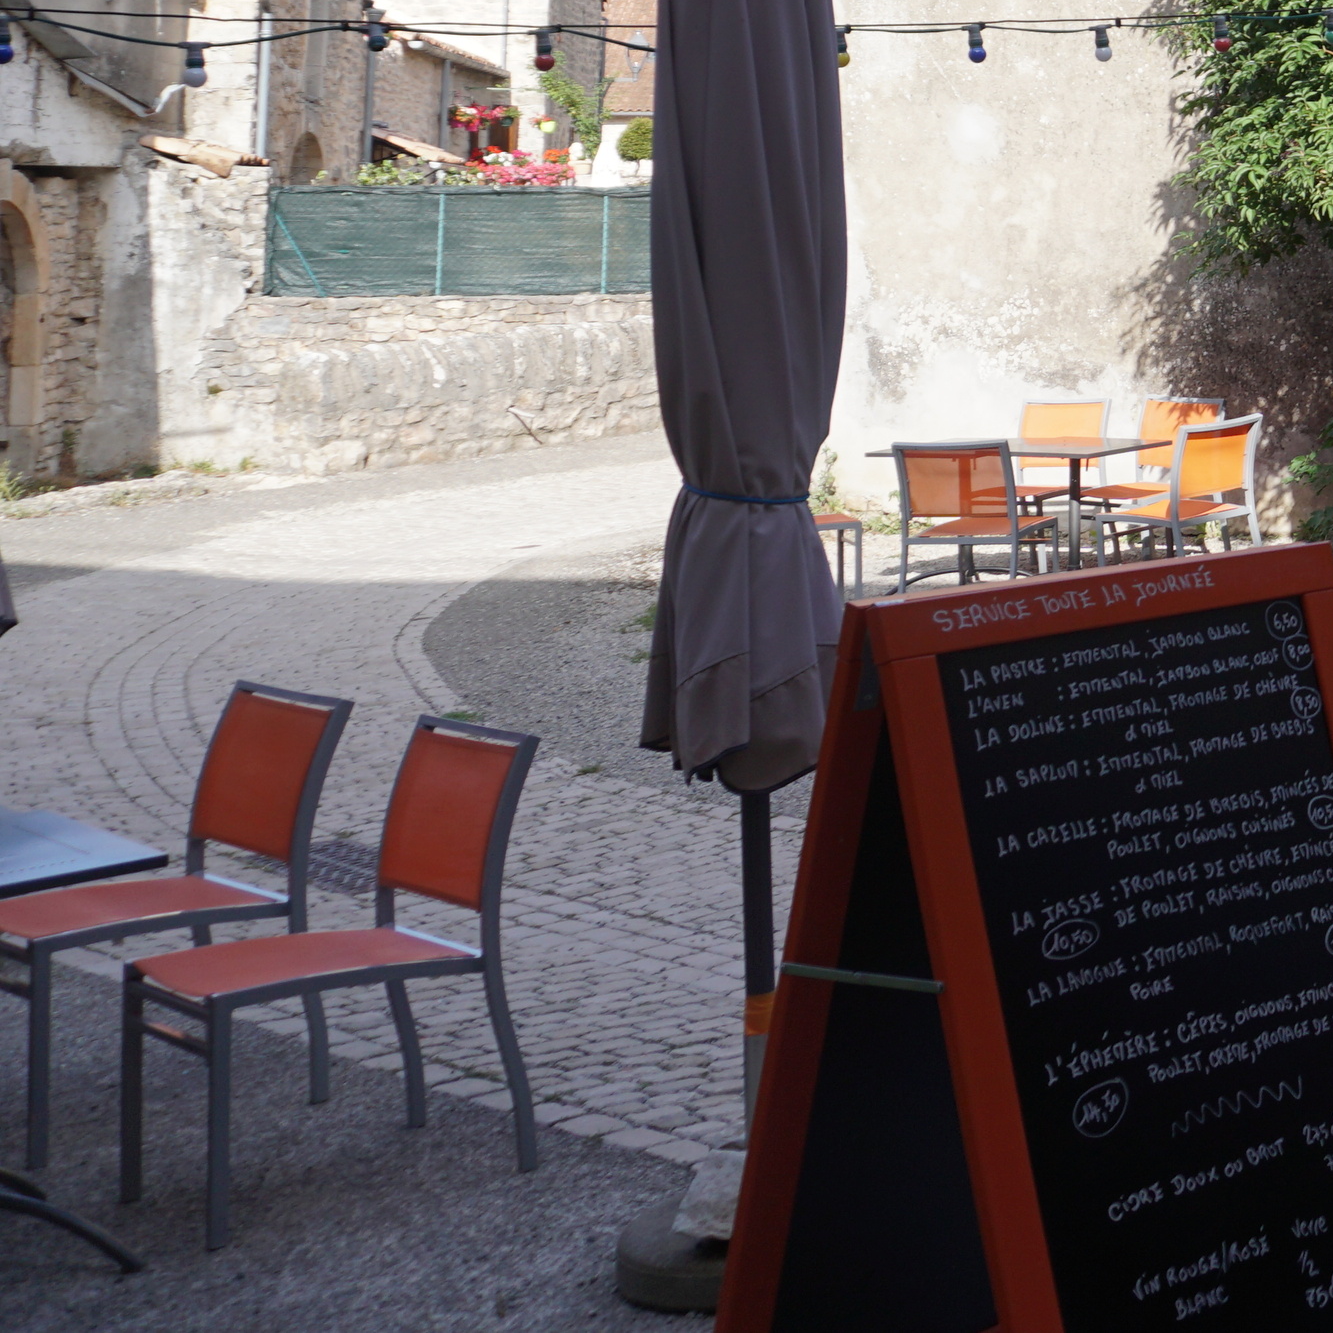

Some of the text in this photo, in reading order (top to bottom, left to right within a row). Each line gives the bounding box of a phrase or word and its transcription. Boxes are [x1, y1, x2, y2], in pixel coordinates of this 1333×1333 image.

[932, 565, 1216, 633] SERVICE TOUTE LA JOURNÉE
[1273, 612, 1298, 632] 6,50
[960, 668, 987, 692] LA
[1148, 630, 1205, 659] JAMBON
[1207, 621, 1251, 641] BLANC
[1286, 643, 1311, 662] 8,00
[968, 692, 1025, 719] L'AVEN
[1156, 666, 1210, 689] JAMBON
[974, 727, 1002, 752] LA
[1168, 685, 1228, 711] FROMAGE
[1233, 680, 1252, 701] DE
[1255, 672, 1299, 697] CHÈVRE
[1295, 694, 1318, 717] 8,50
[1140, 719, 1175, 738] MIEL
[984, 774, 1009, 799] LA
[1189, 731, 1248, 758] FROMAGE
[1250, 723, 1268, 744] DE
[1271, 718, 1315, 739] BREBIS
[1151, 770, 1184, 790] MIEL
[996, 833, 1021, 858] LA
[1112, 804, 1180, 834] FROMAGE
[1183, 799, 1205, 822] DE
[1174, 822, 1237, 849] OIGNONS
[1241, 806, 1296, 836] CUISINÉS
[1012, 911, 1036, 936] LA
[1119, 861, 1199, 899] FROMAGE
[1203, 858, 1225, 880] DE
[1114, 905, 1138, 928] DE
[1271, 868, 1325, 894] OIGNONS
[1052, 928, 1095, 954] 10,50
[1026, 981, 1053, 1008] LA
[1128, 974, 1176, 1001] POIRE
[1254, 1019, 1310, 1055] FROMAGE
[1312, 1015, 1331, 1036] DE
[1108, 1181, 1165, 1222] CIDRE
[1170, 1165, 1220, 1196] DOUX
[1224, 1158, 1244, 1178] OU
[1245, 1136, 1285, 1166] BRUT
[1132, 1271, 1161, 1302] VIN
[1175, 1284, 1230, 1322] BLANC
